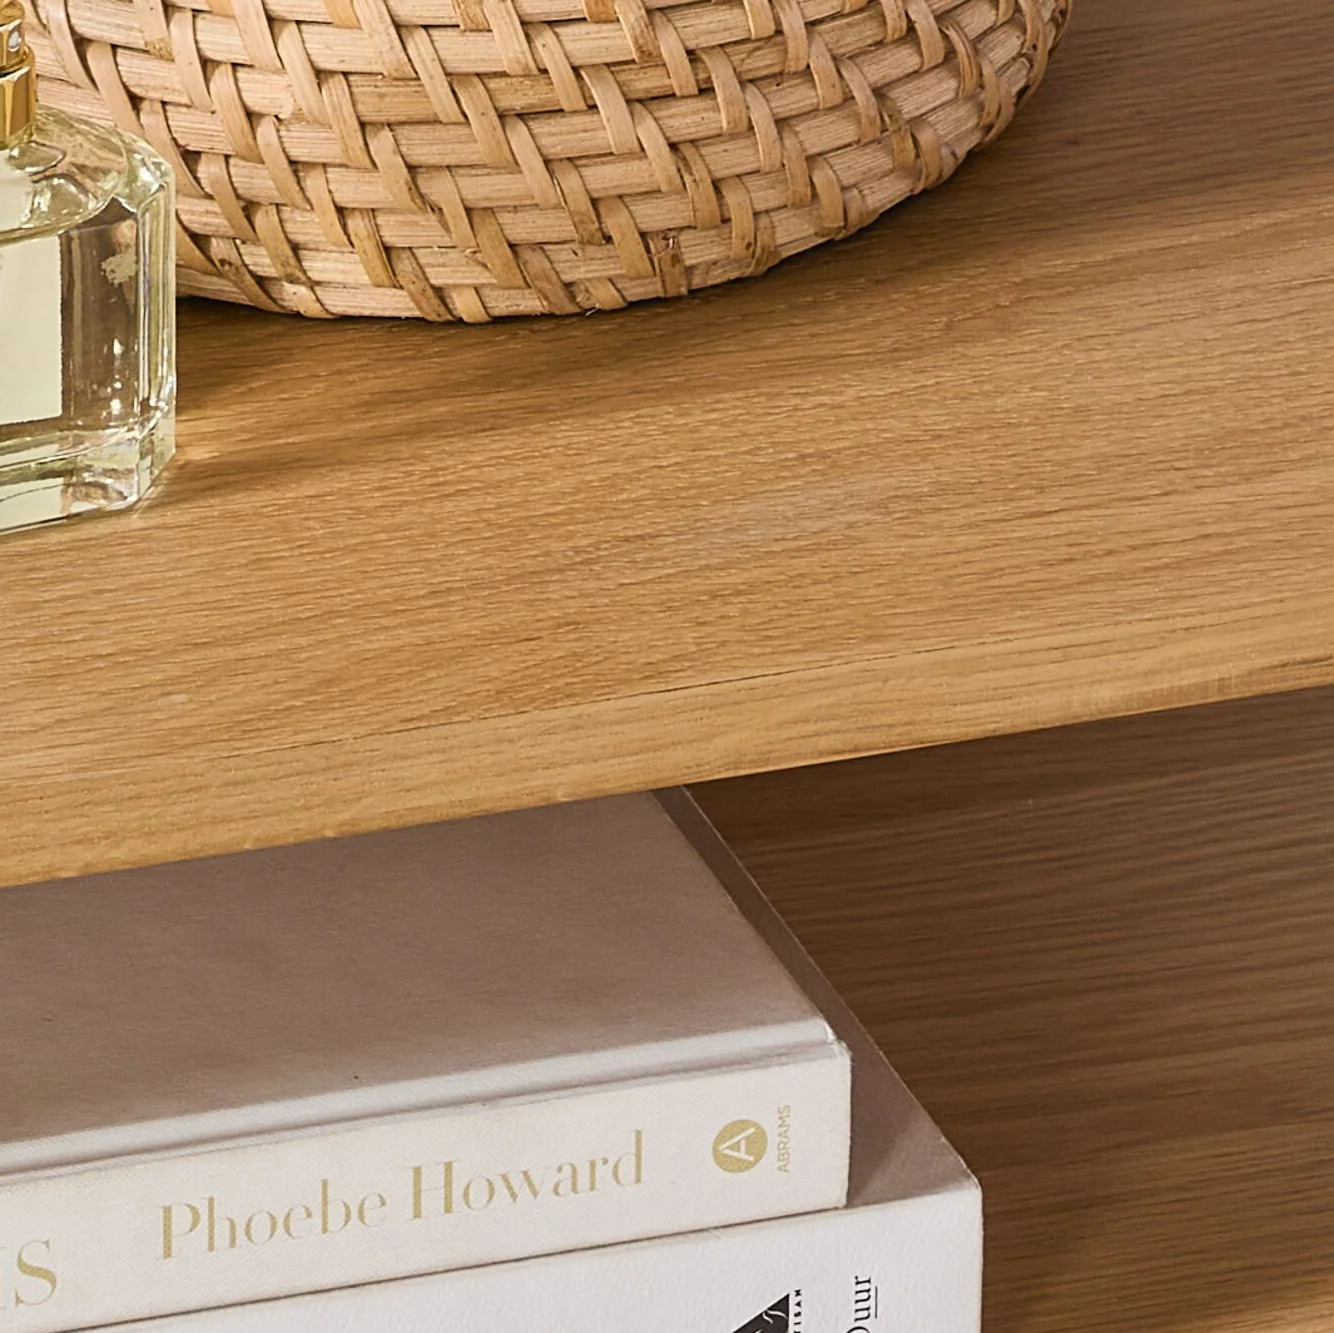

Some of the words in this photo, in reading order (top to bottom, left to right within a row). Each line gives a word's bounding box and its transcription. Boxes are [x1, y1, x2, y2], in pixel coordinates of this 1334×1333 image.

[776, 1104, 792, 1173] ABRAMS
[158, 1178, 388, 1262] Phoebe
[409, 1129, 647, 1221] Howard
